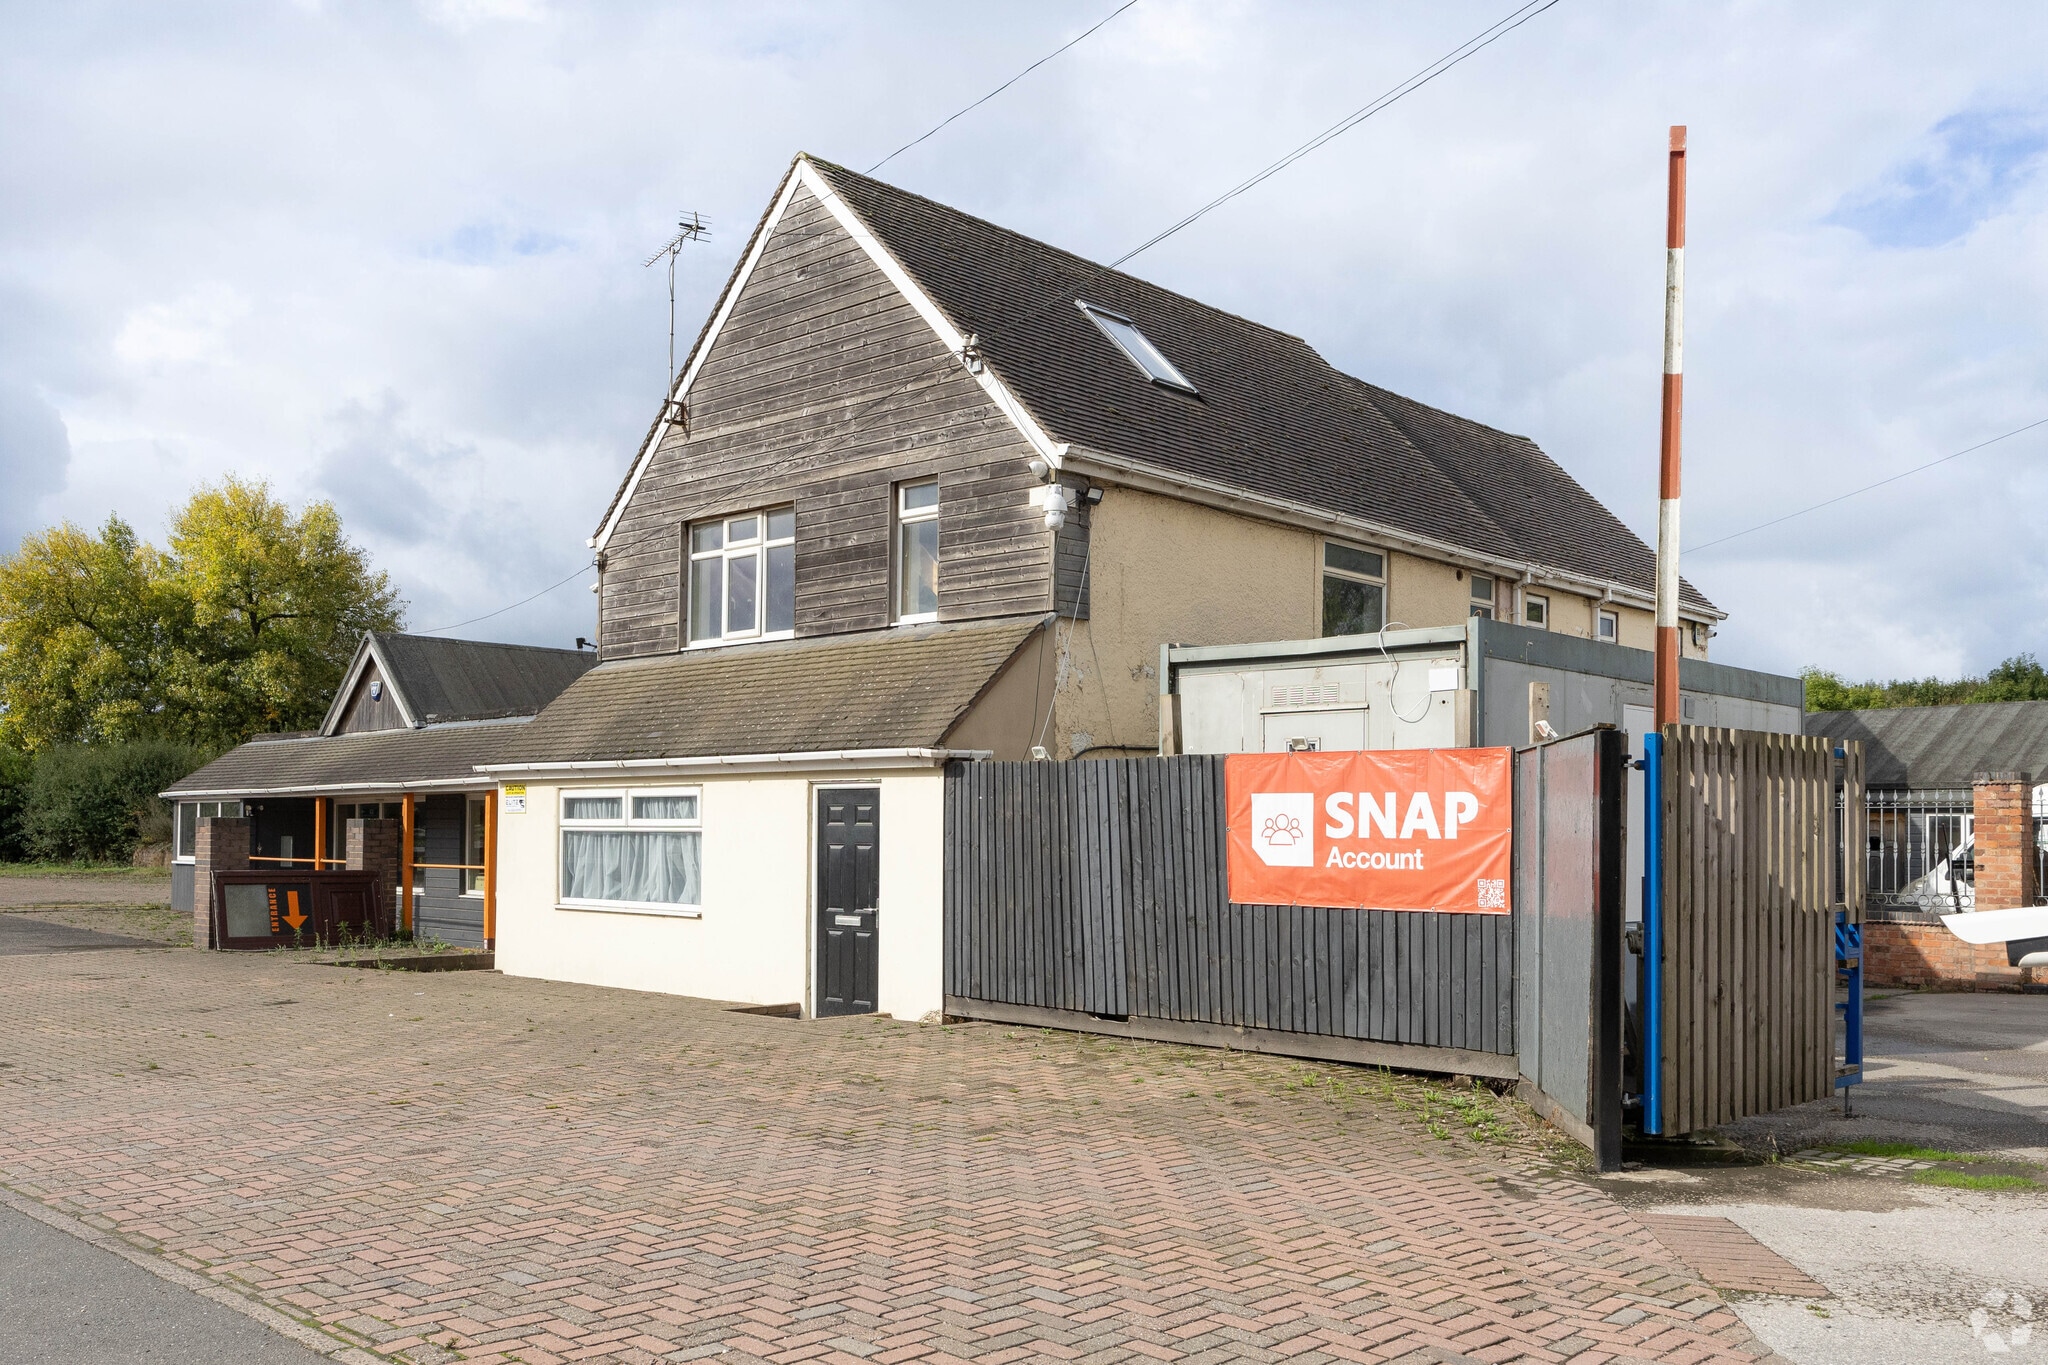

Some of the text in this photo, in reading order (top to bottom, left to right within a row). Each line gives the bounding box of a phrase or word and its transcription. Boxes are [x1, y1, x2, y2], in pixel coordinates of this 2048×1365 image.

[1325, 791, 1479, 840] SNAP
[1325, 846, 1424, 870] Account
[268, 887, 279, 932] ENTRANCE
